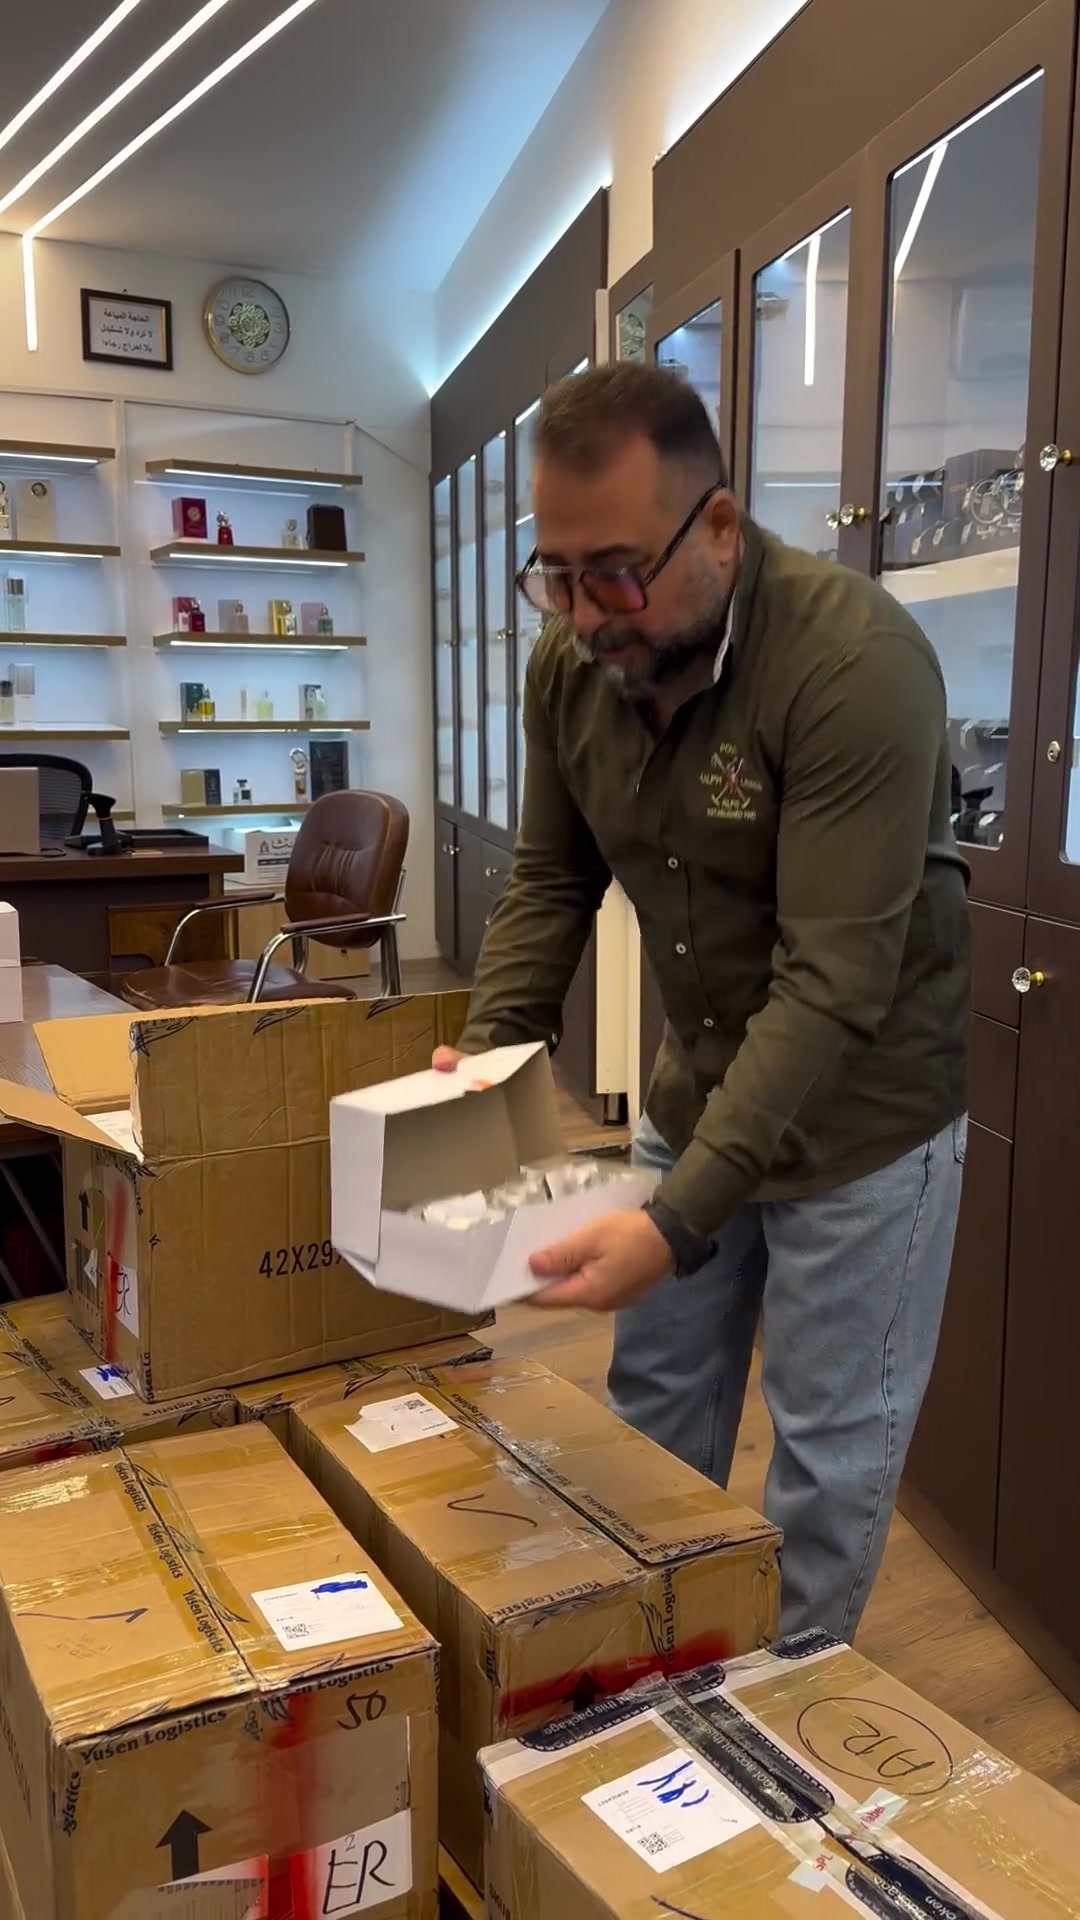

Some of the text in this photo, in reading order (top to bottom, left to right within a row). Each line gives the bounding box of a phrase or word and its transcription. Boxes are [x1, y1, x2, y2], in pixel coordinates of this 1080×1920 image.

[123, 1478, 148, 1513] Logistics
[147, 1521, 184, 1580] Yusen Logistics
[555, 1579, 604, 1598] Yusen
[182, 1589, 226, 1654] Yusen Logistics
[80, 1708, 228, 1765] Yusen Logistics
[543, 1709, 596, 1737] package
[62, 1770, 82, 1838] gistics
[322, 1839, 396, 1915] ER
